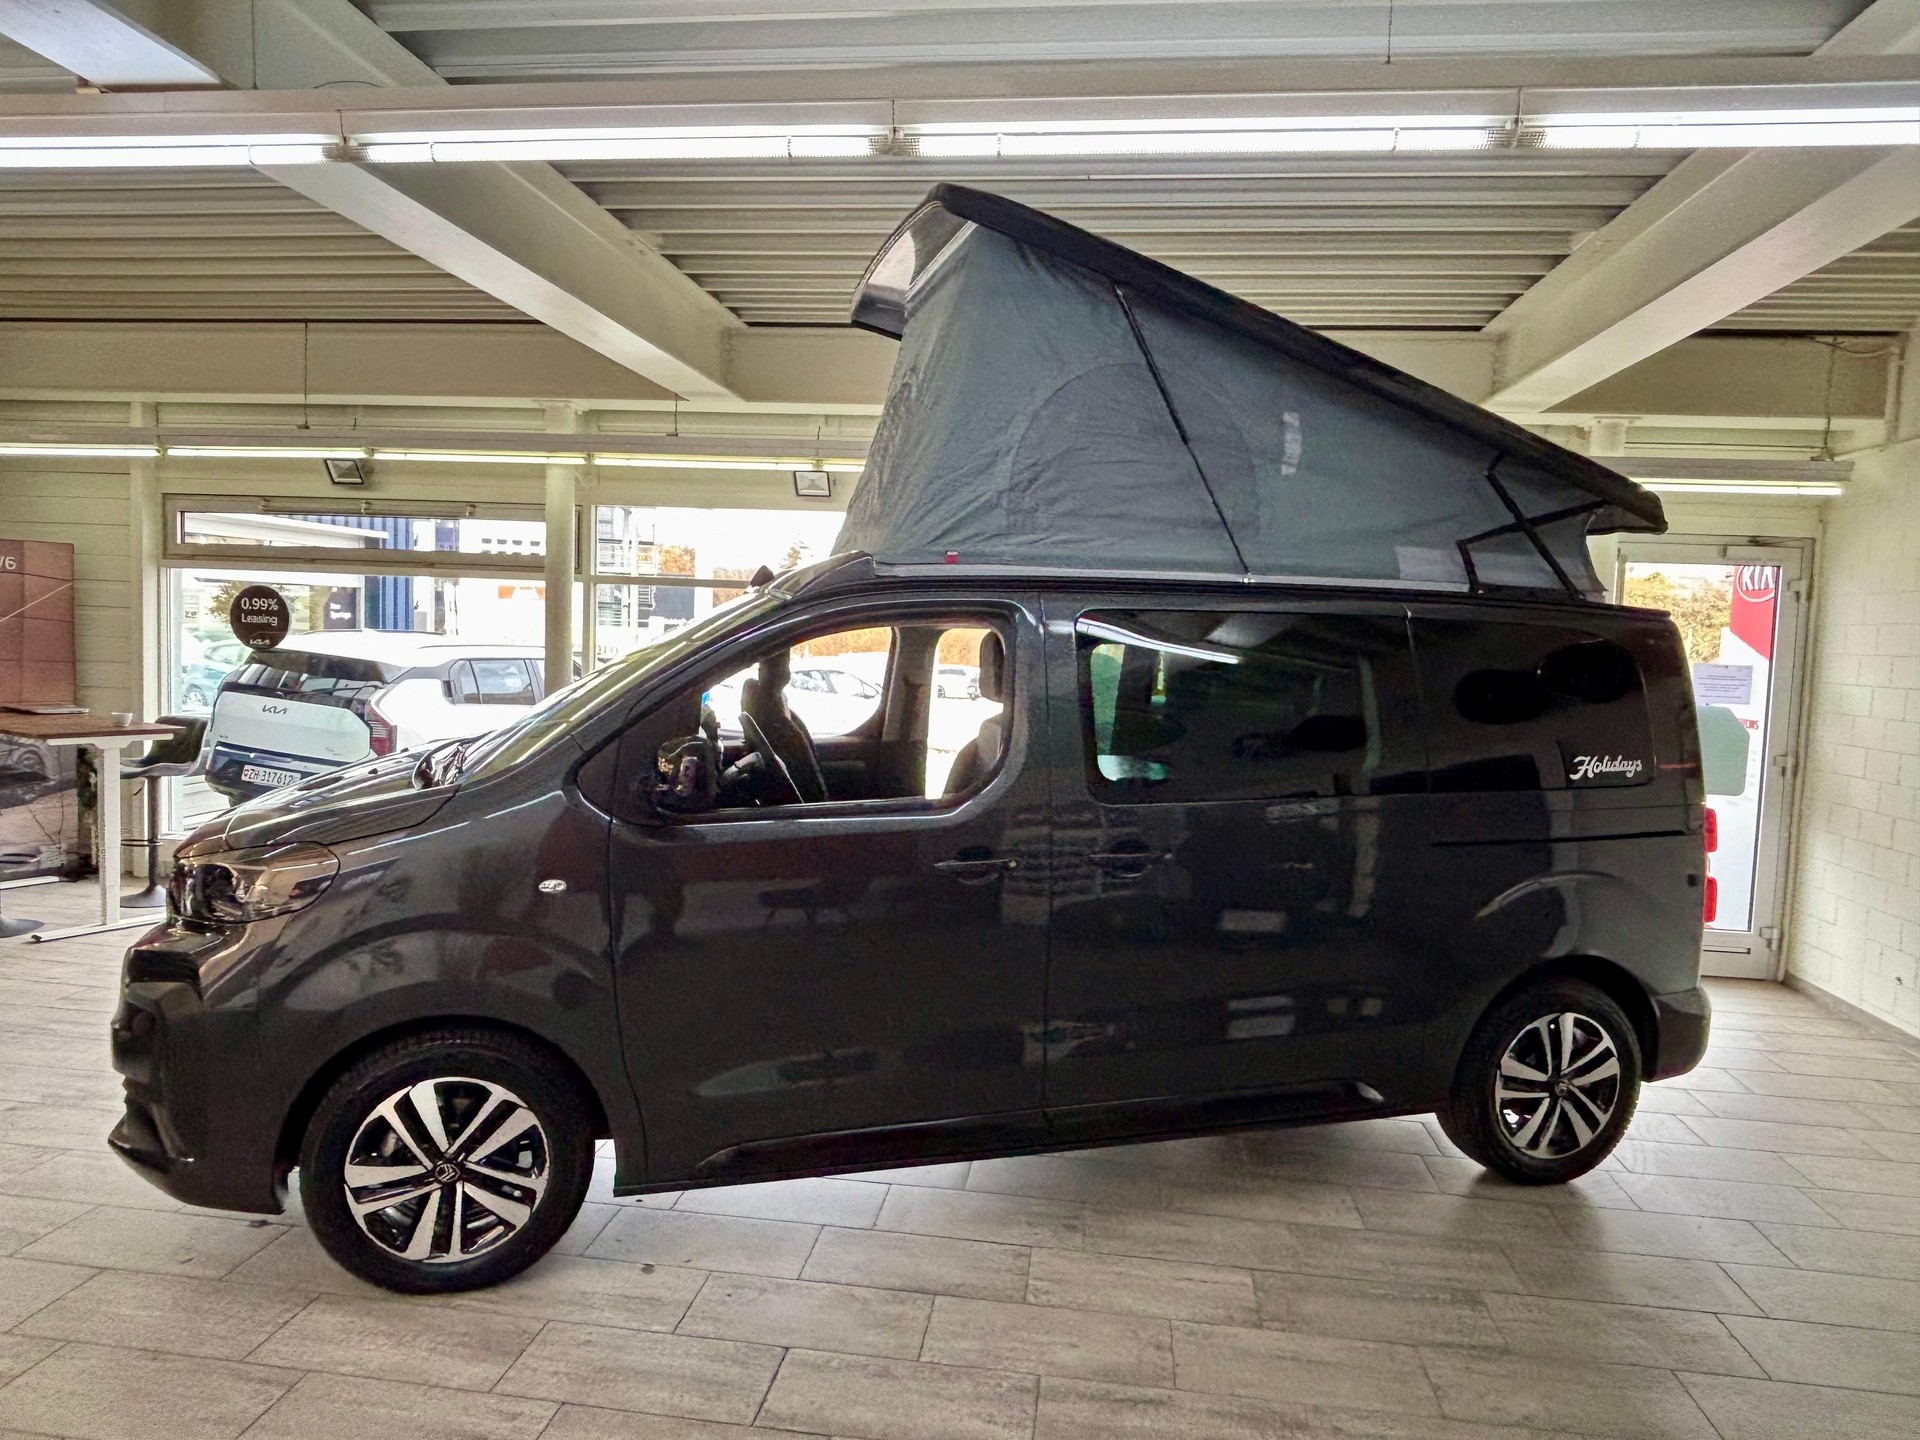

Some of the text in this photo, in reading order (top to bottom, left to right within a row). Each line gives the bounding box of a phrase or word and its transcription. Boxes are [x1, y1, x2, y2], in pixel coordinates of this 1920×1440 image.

[1742, 566, 1775, 591] KIA
[241, 597, 279, 611] 0.99%
[241, 613, 278, 626] Leasing
[1569, 755, 1643, 780] Holidays
[248, 768, 294, 786] ZH 317612
